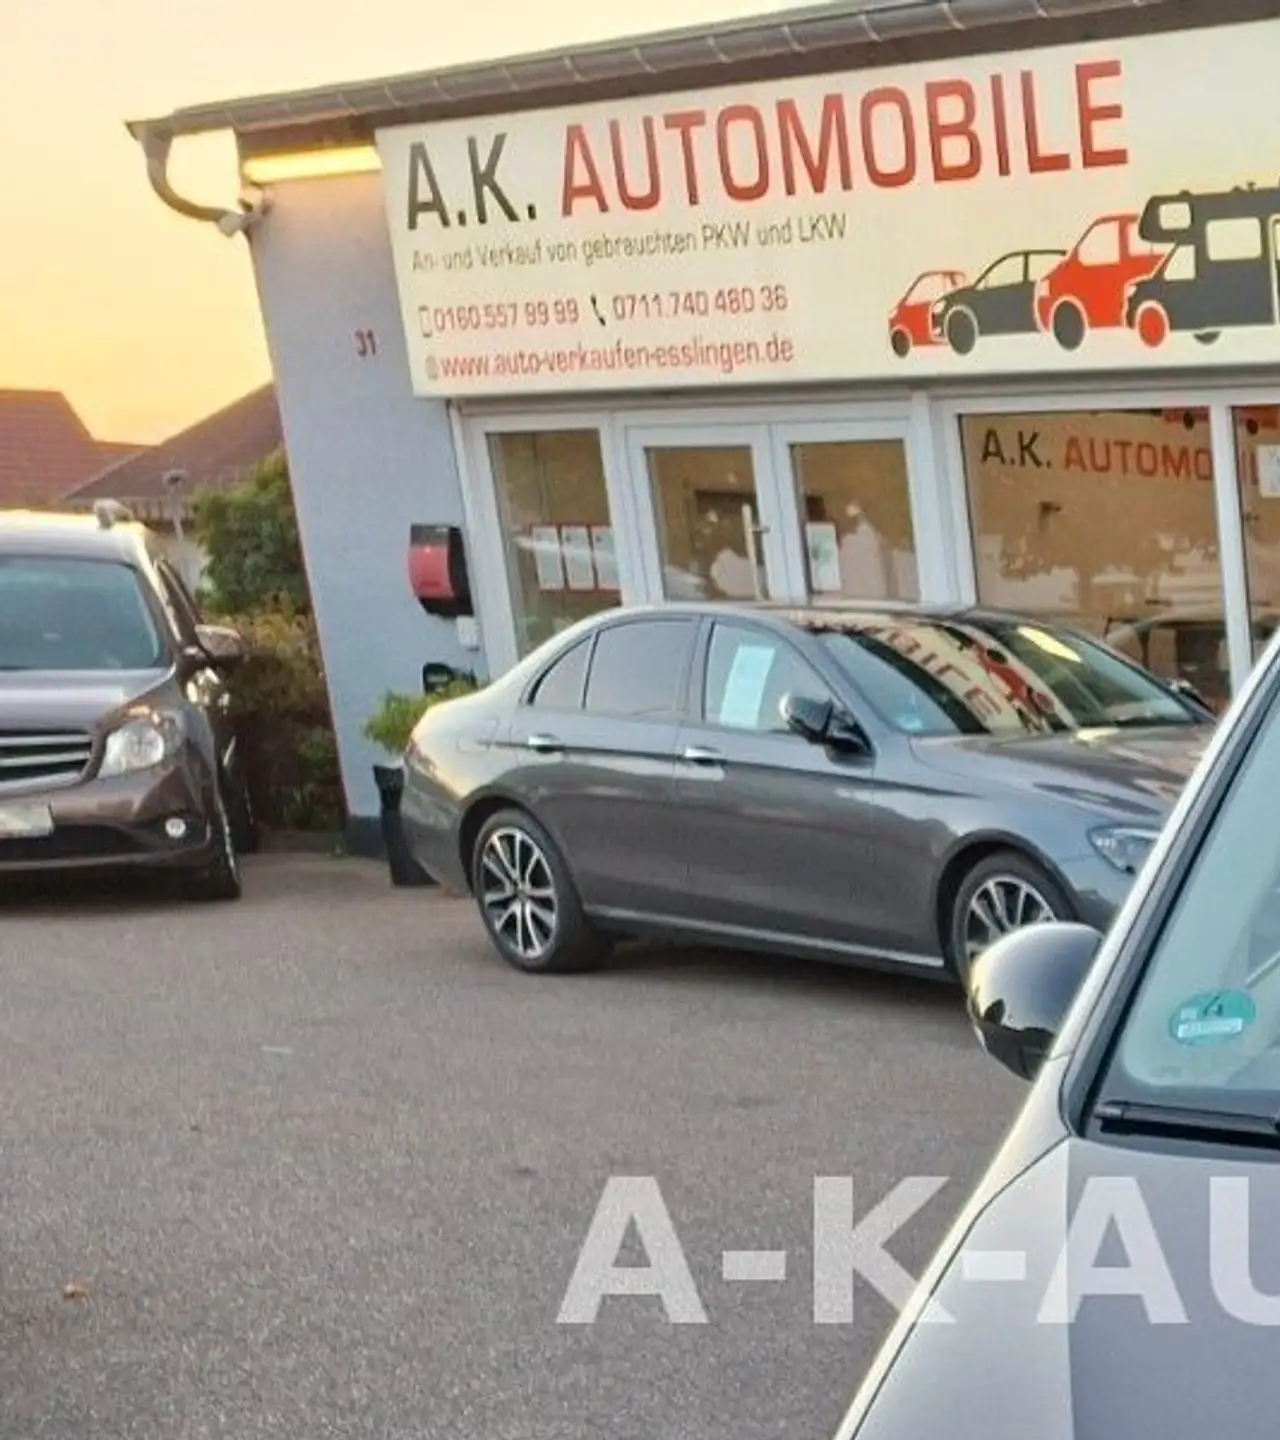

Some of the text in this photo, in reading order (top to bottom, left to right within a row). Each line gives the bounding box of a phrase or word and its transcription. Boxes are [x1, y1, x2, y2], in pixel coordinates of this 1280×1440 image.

[408, 60, 1128, 231] A.K. AUTOMOBILE
[443, 247, 473, 270] und
[477, 239, 542, 267] Verkauf
[547, 244, 577, 263] von
[583, 232, 697, 267] gebrauchten
[702, 221, 751, 250] PKW
[757, 217, 792, 246] und
[799, 213, 847, 243] LKW
[761, 284, 789, 311] 36
[354, 329, 376, 357] 31
[440, 332, 794, 377] www.auto-verkaufen-esslingen.de
[981, 428, 1052, 468] A.K.
